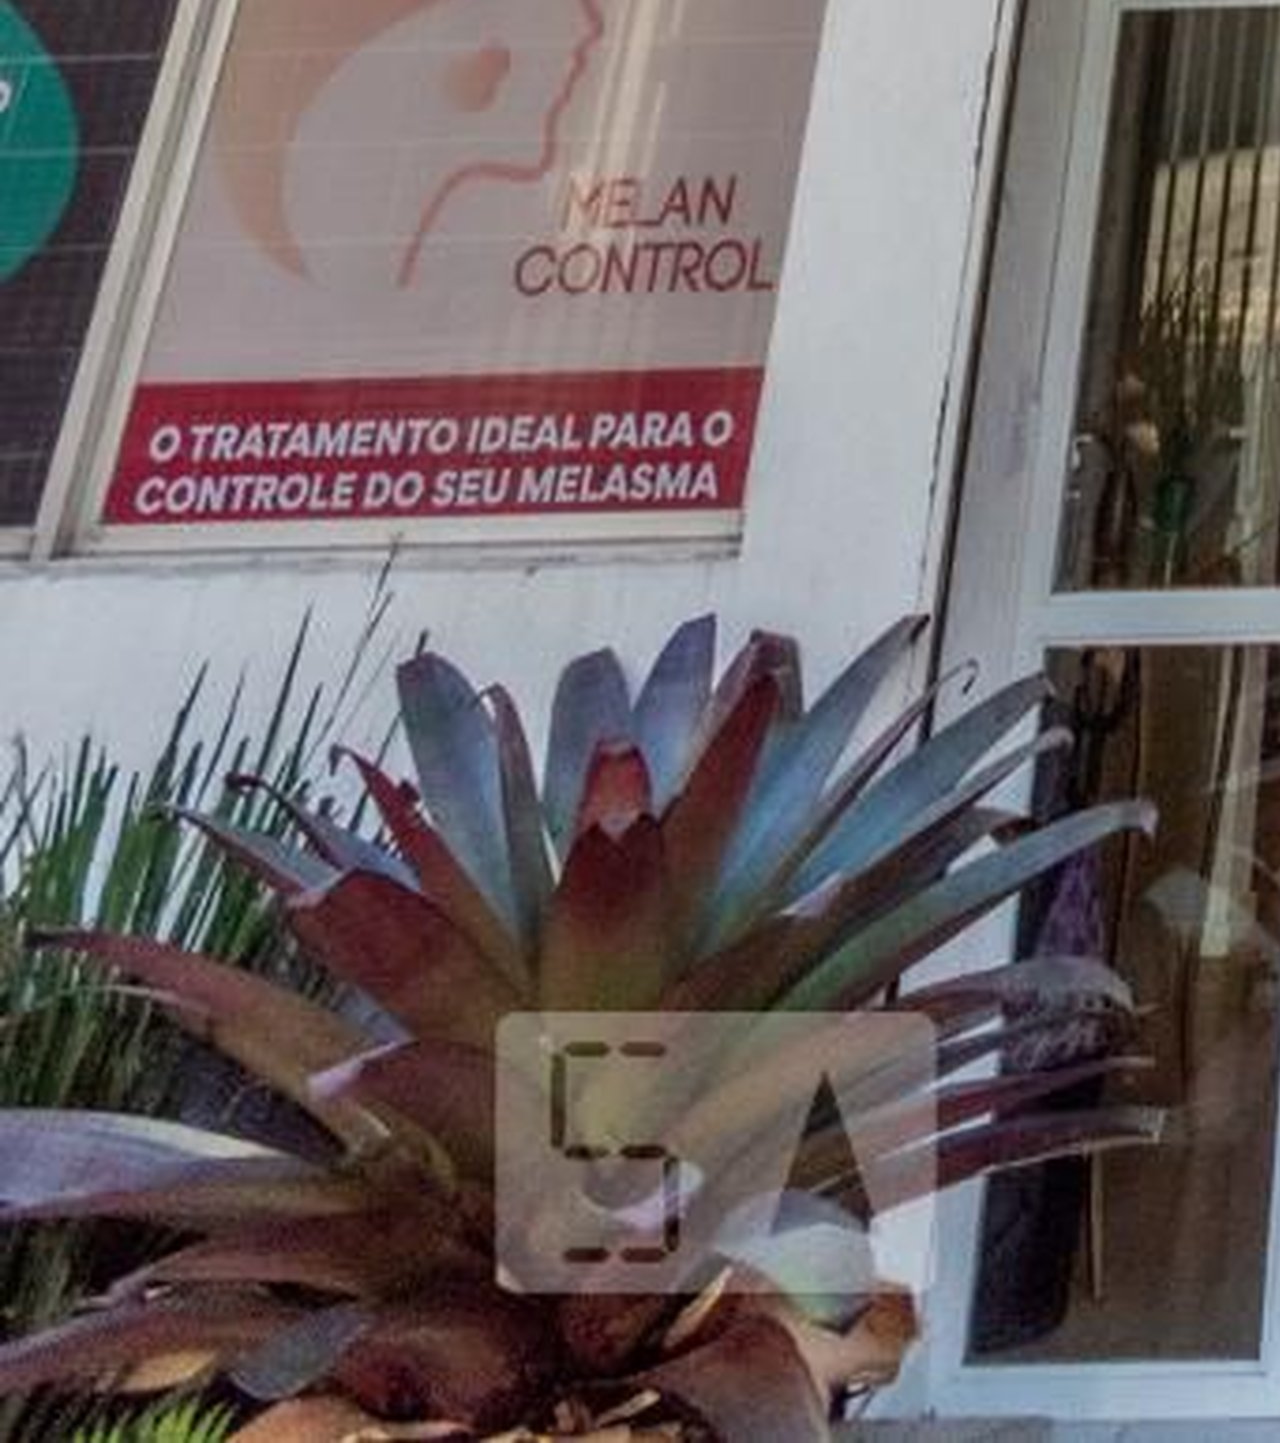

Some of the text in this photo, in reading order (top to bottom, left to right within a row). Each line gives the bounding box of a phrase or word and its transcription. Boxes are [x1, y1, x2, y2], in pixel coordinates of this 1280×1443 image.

[514, 237, 775, 296] CONTROL
[150, 409, 734, 462] O TRATAMENTO IDEAL PARA O
[135, 461, 719, 515] CONTROLE DO SEU MELASMA
